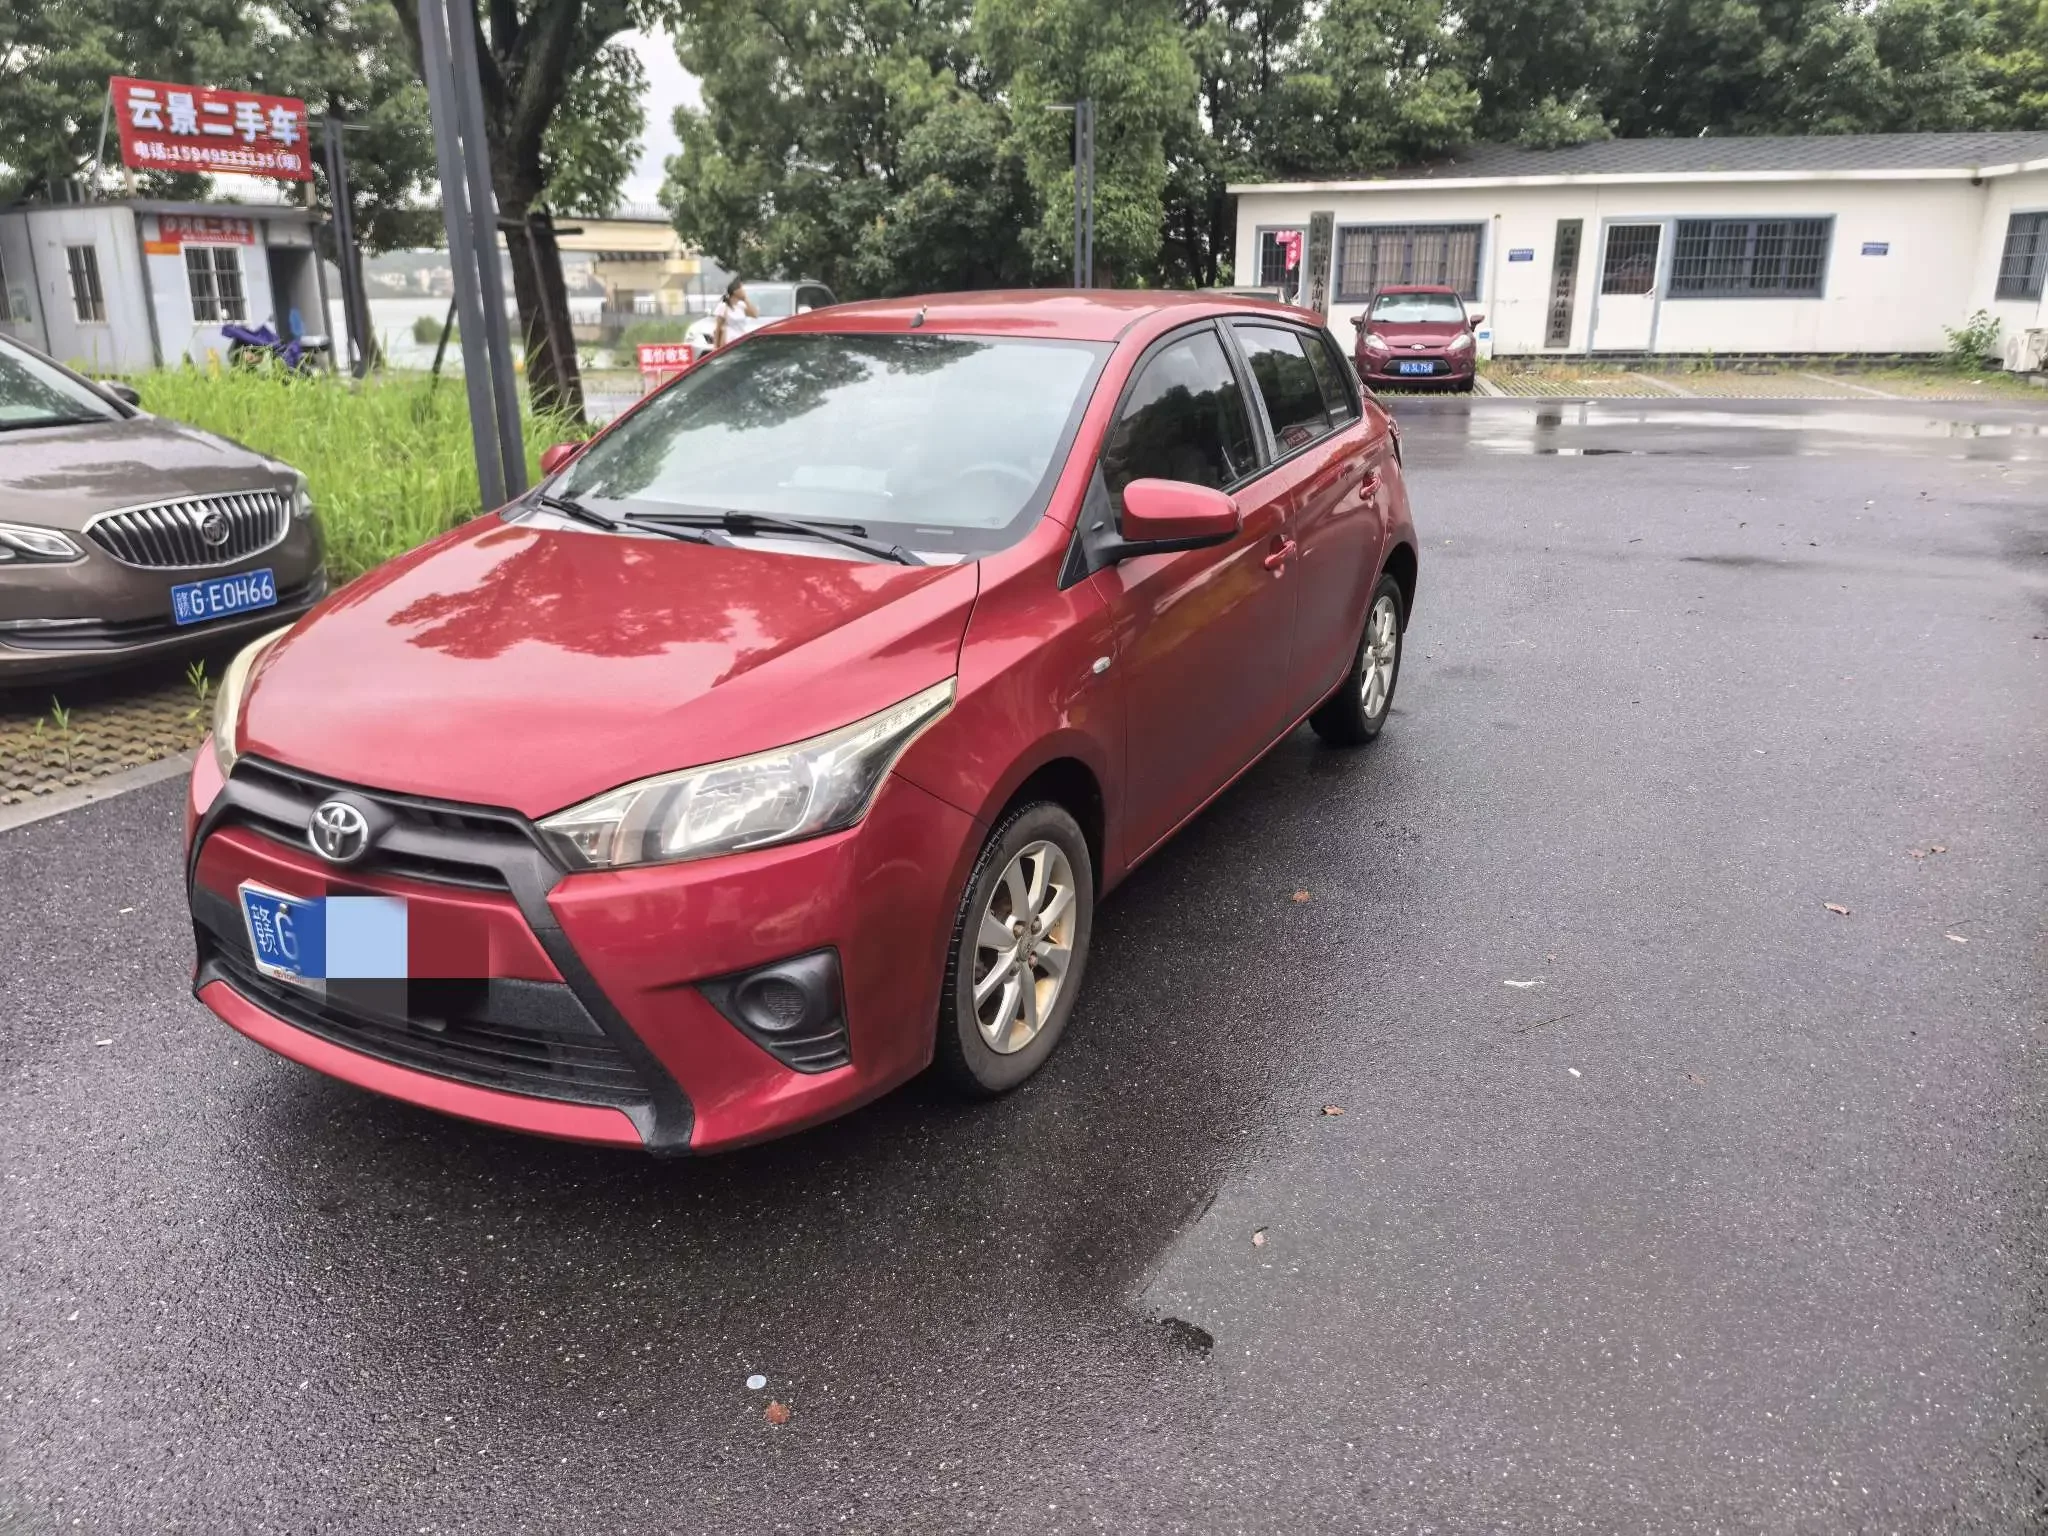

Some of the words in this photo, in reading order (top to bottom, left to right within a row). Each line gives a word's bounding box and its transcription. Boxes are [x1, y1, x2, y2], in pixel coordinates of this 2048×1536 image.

[128, 87, 301, 146] 云景二手车
